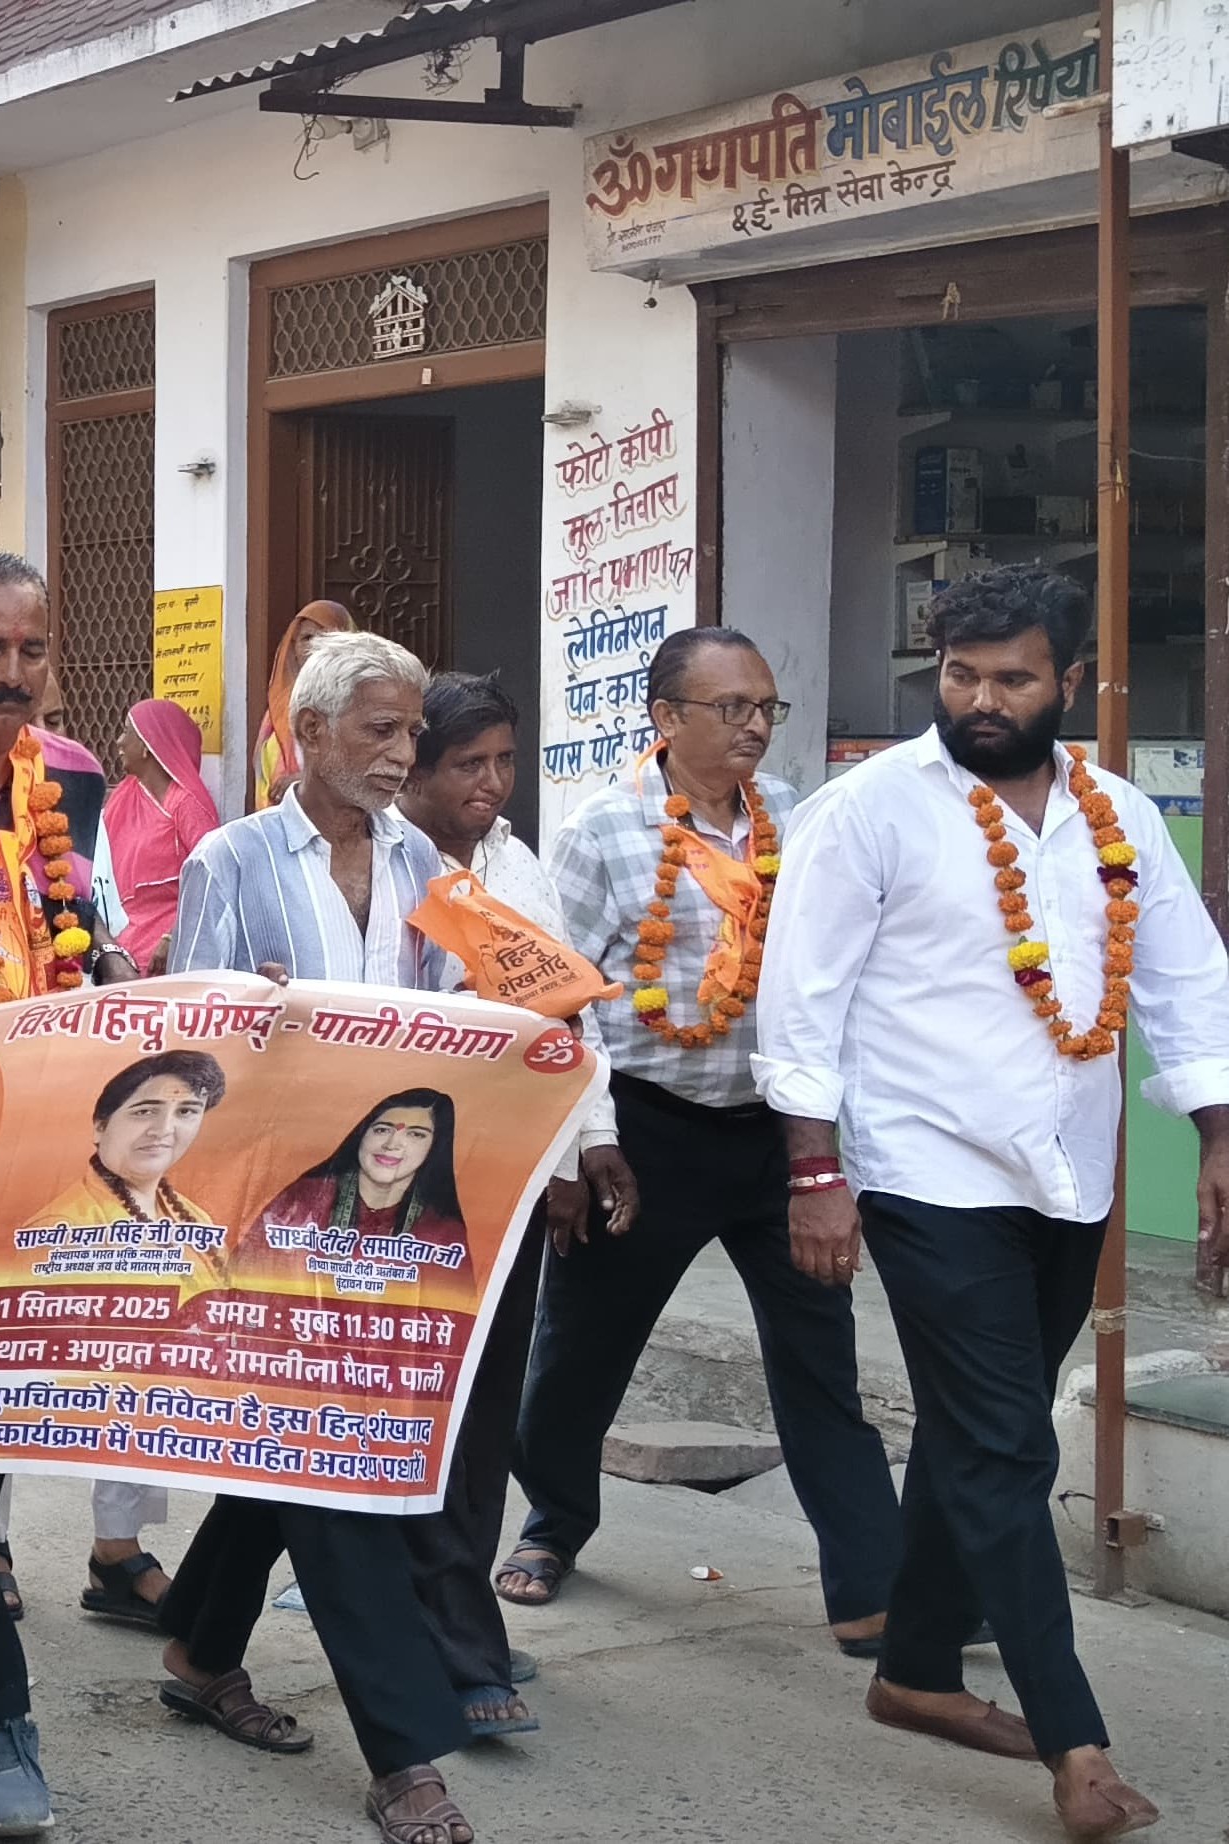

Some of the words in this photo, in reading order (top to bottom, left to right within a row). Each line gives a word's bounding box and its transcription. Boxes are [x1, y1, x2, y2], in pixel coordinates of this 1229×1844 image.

[825, 51, 988, 160] मोबाईल
[837, 169, 886, 206] सेवा
[888, 159, 957, 198] केन्द्र
[555, 432, 613, 489] फोटो
[617, 407, 674, 468] कॉपी
[563, 604, 668, 669] लेमिनेशन
[543, 740, 586, 776] पास
[495, 940, 550, 972] हिन्दू
[497, 953, 570, 998] शंखनाद
[8, 1001, 90, 1041] विश्व
[92, 991, 168, 1051] हिन्दू
[312, 1006, 402, 1048] पाली
[401, 1011, 514, 1060] विभाग
[16, 1223, 68, 1248] साध्वी
[71, 1226, 107, 1246] प्रज्ञा
[110, 1219, 142, 1243] सिंह
[147, 1219, 170, 1243] जी
[175, 1223, 226, 1249] ठाकुर
[91, 1249, 114, 1260] भारत
[268, 1224, 317, 1249] साध्वी
[320, 1229, 357, 1255] दीदी
[363, 1234, 434, 1263] समाहिता
[436, 1244, 463, 1267] जी
[96, 1261, 112, 1272] जय
[354, 1261, 374, 1277] दीदी
[406, 1266, 417, 1280] जी
[17, 1290, 106, 1320] सितम्बर
[110, 1296, 171, 1321] 2025
[206, 1300, 269, 1328] समय
[289, 1307, 340, 1342] सुबह
[344, 1313, 395, 1341] 11.30
[400, 1312, 433, 1344] बजे
[436, 1314, 456, 1346] से
[65, 1339, 156, 1371] अणुव्रत
[225, 1348, 339, 1385] रामलीला
[400, 1361, 445, 1393] पाली
[115, 1384, 139, 1413] से
[146, 1386, 235, 1423] निवेदन
[240, 1395, 262, 1428] है
[268, 1405, 311, 1434] इस
[107, 1422, 131, 1450] में
[135, 1426, 225, 1460] परिवार
[230, 1437, 304, 1471] सहित
